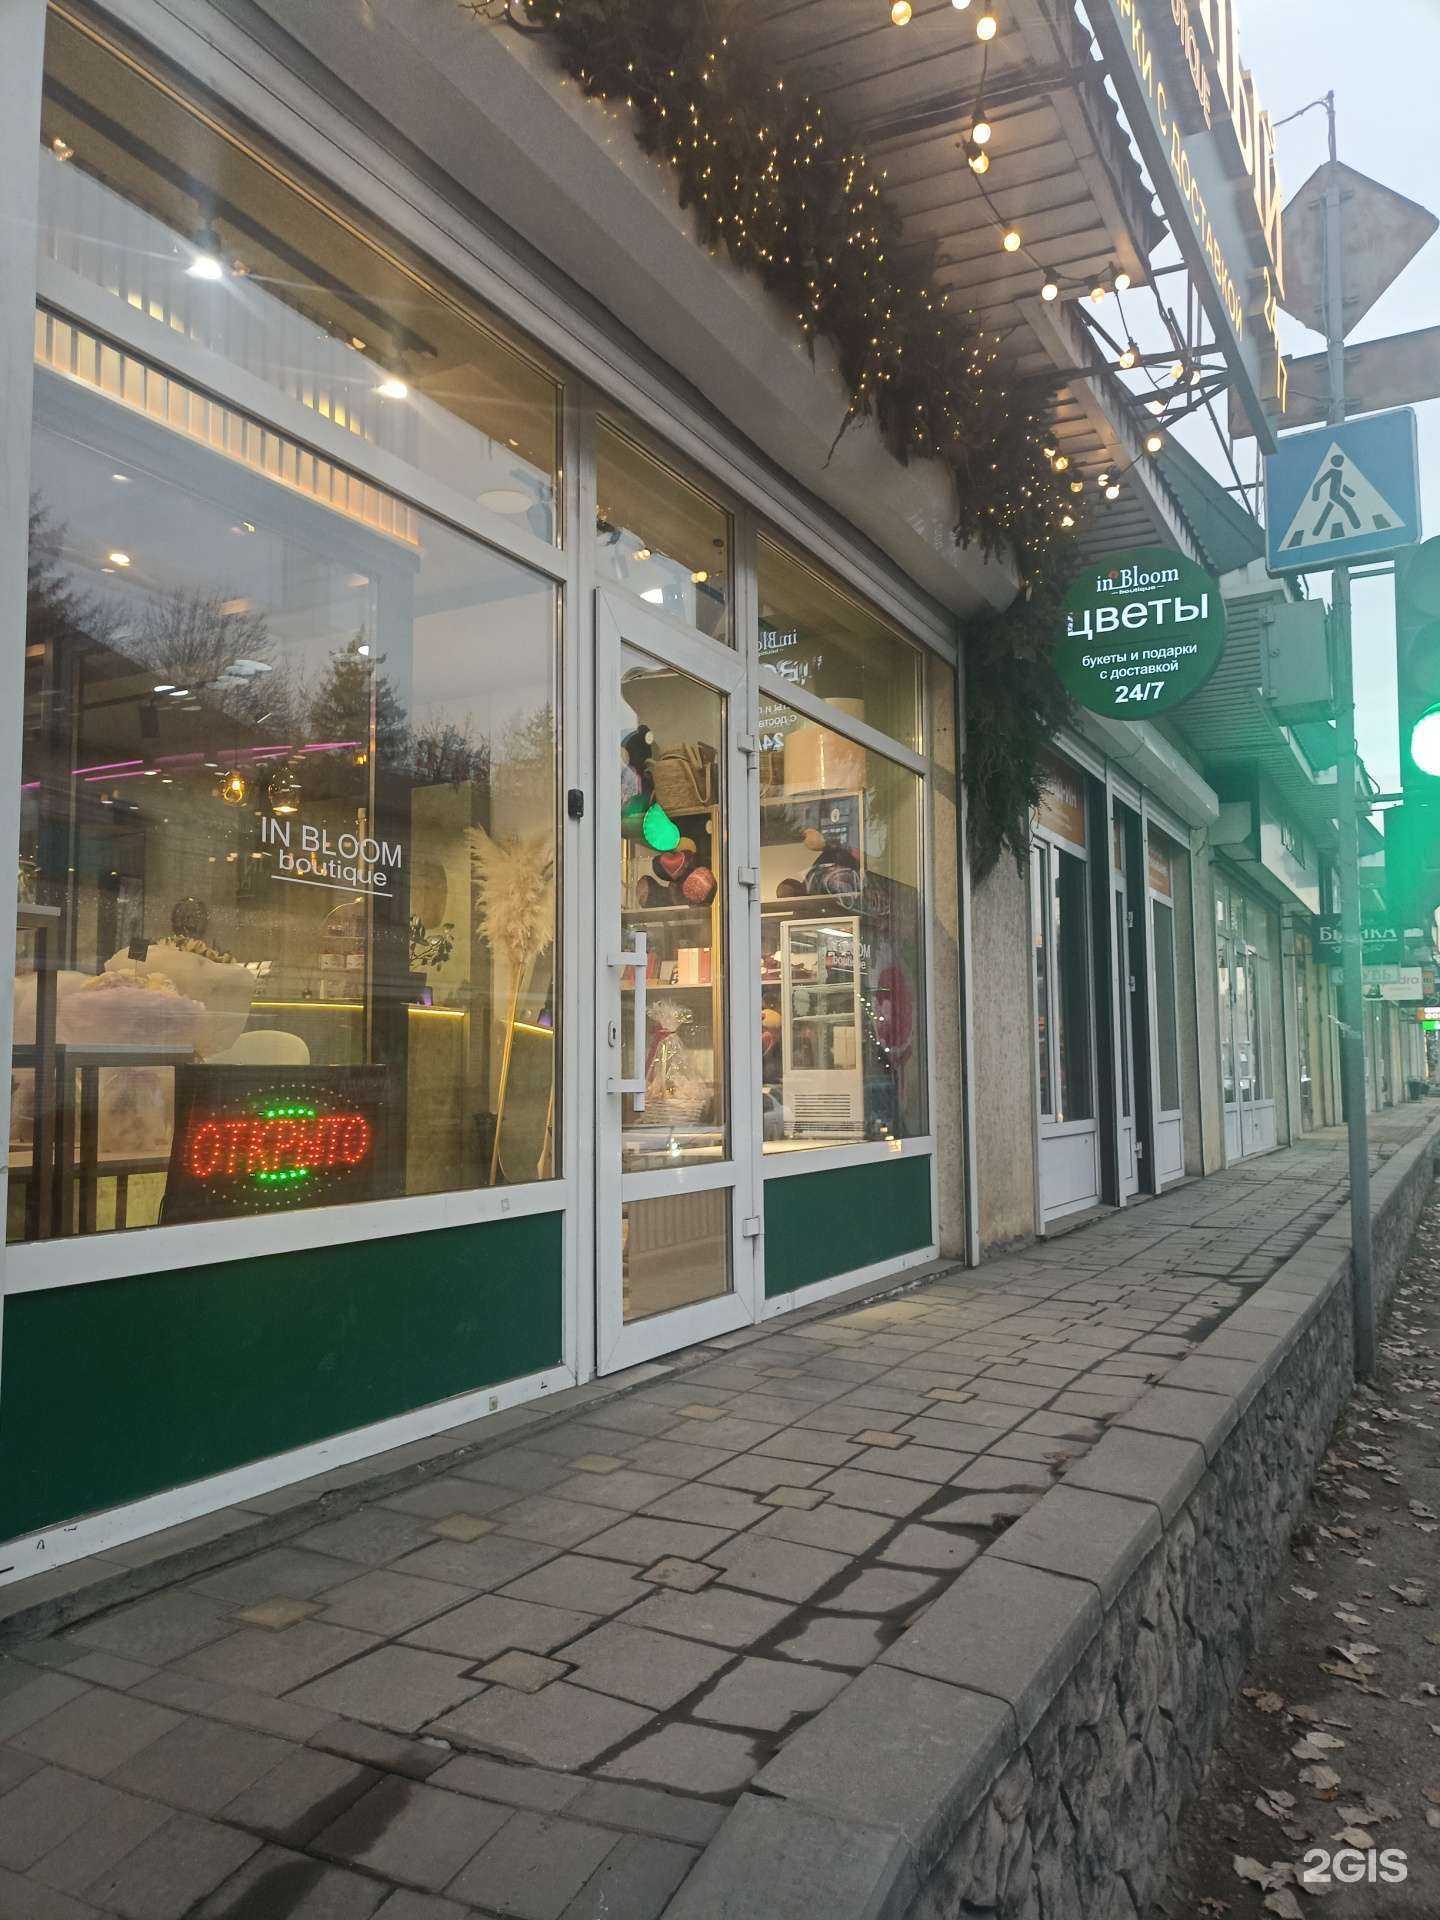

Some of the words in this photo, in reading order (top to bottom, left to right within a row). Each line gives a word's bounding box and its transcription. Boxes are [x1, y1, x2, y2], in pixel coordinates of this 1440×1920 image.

[1171, 120, 1243, 342] ДОСТАВКОЙ
[1096, 575, 1114, 592] in
[1119, 565, 1180, 588] Bloom
[1082, 650, 1127, 668] букеты
[1130, 651, 1139, 661] и
[1142, 643, 1198, 662] подарки
[1099, 670, 1108, 680] с
[1109, 659, 1179, 680] доставкой
[1115, 681, 1165, 703] 24/7
[261, 816, 290, 848] IN
[301, 824, 402, 869] BLOOM
[279, 849, 387, 887] boutique
[192, 1115, 368, 1177] ОТКРЫТО
